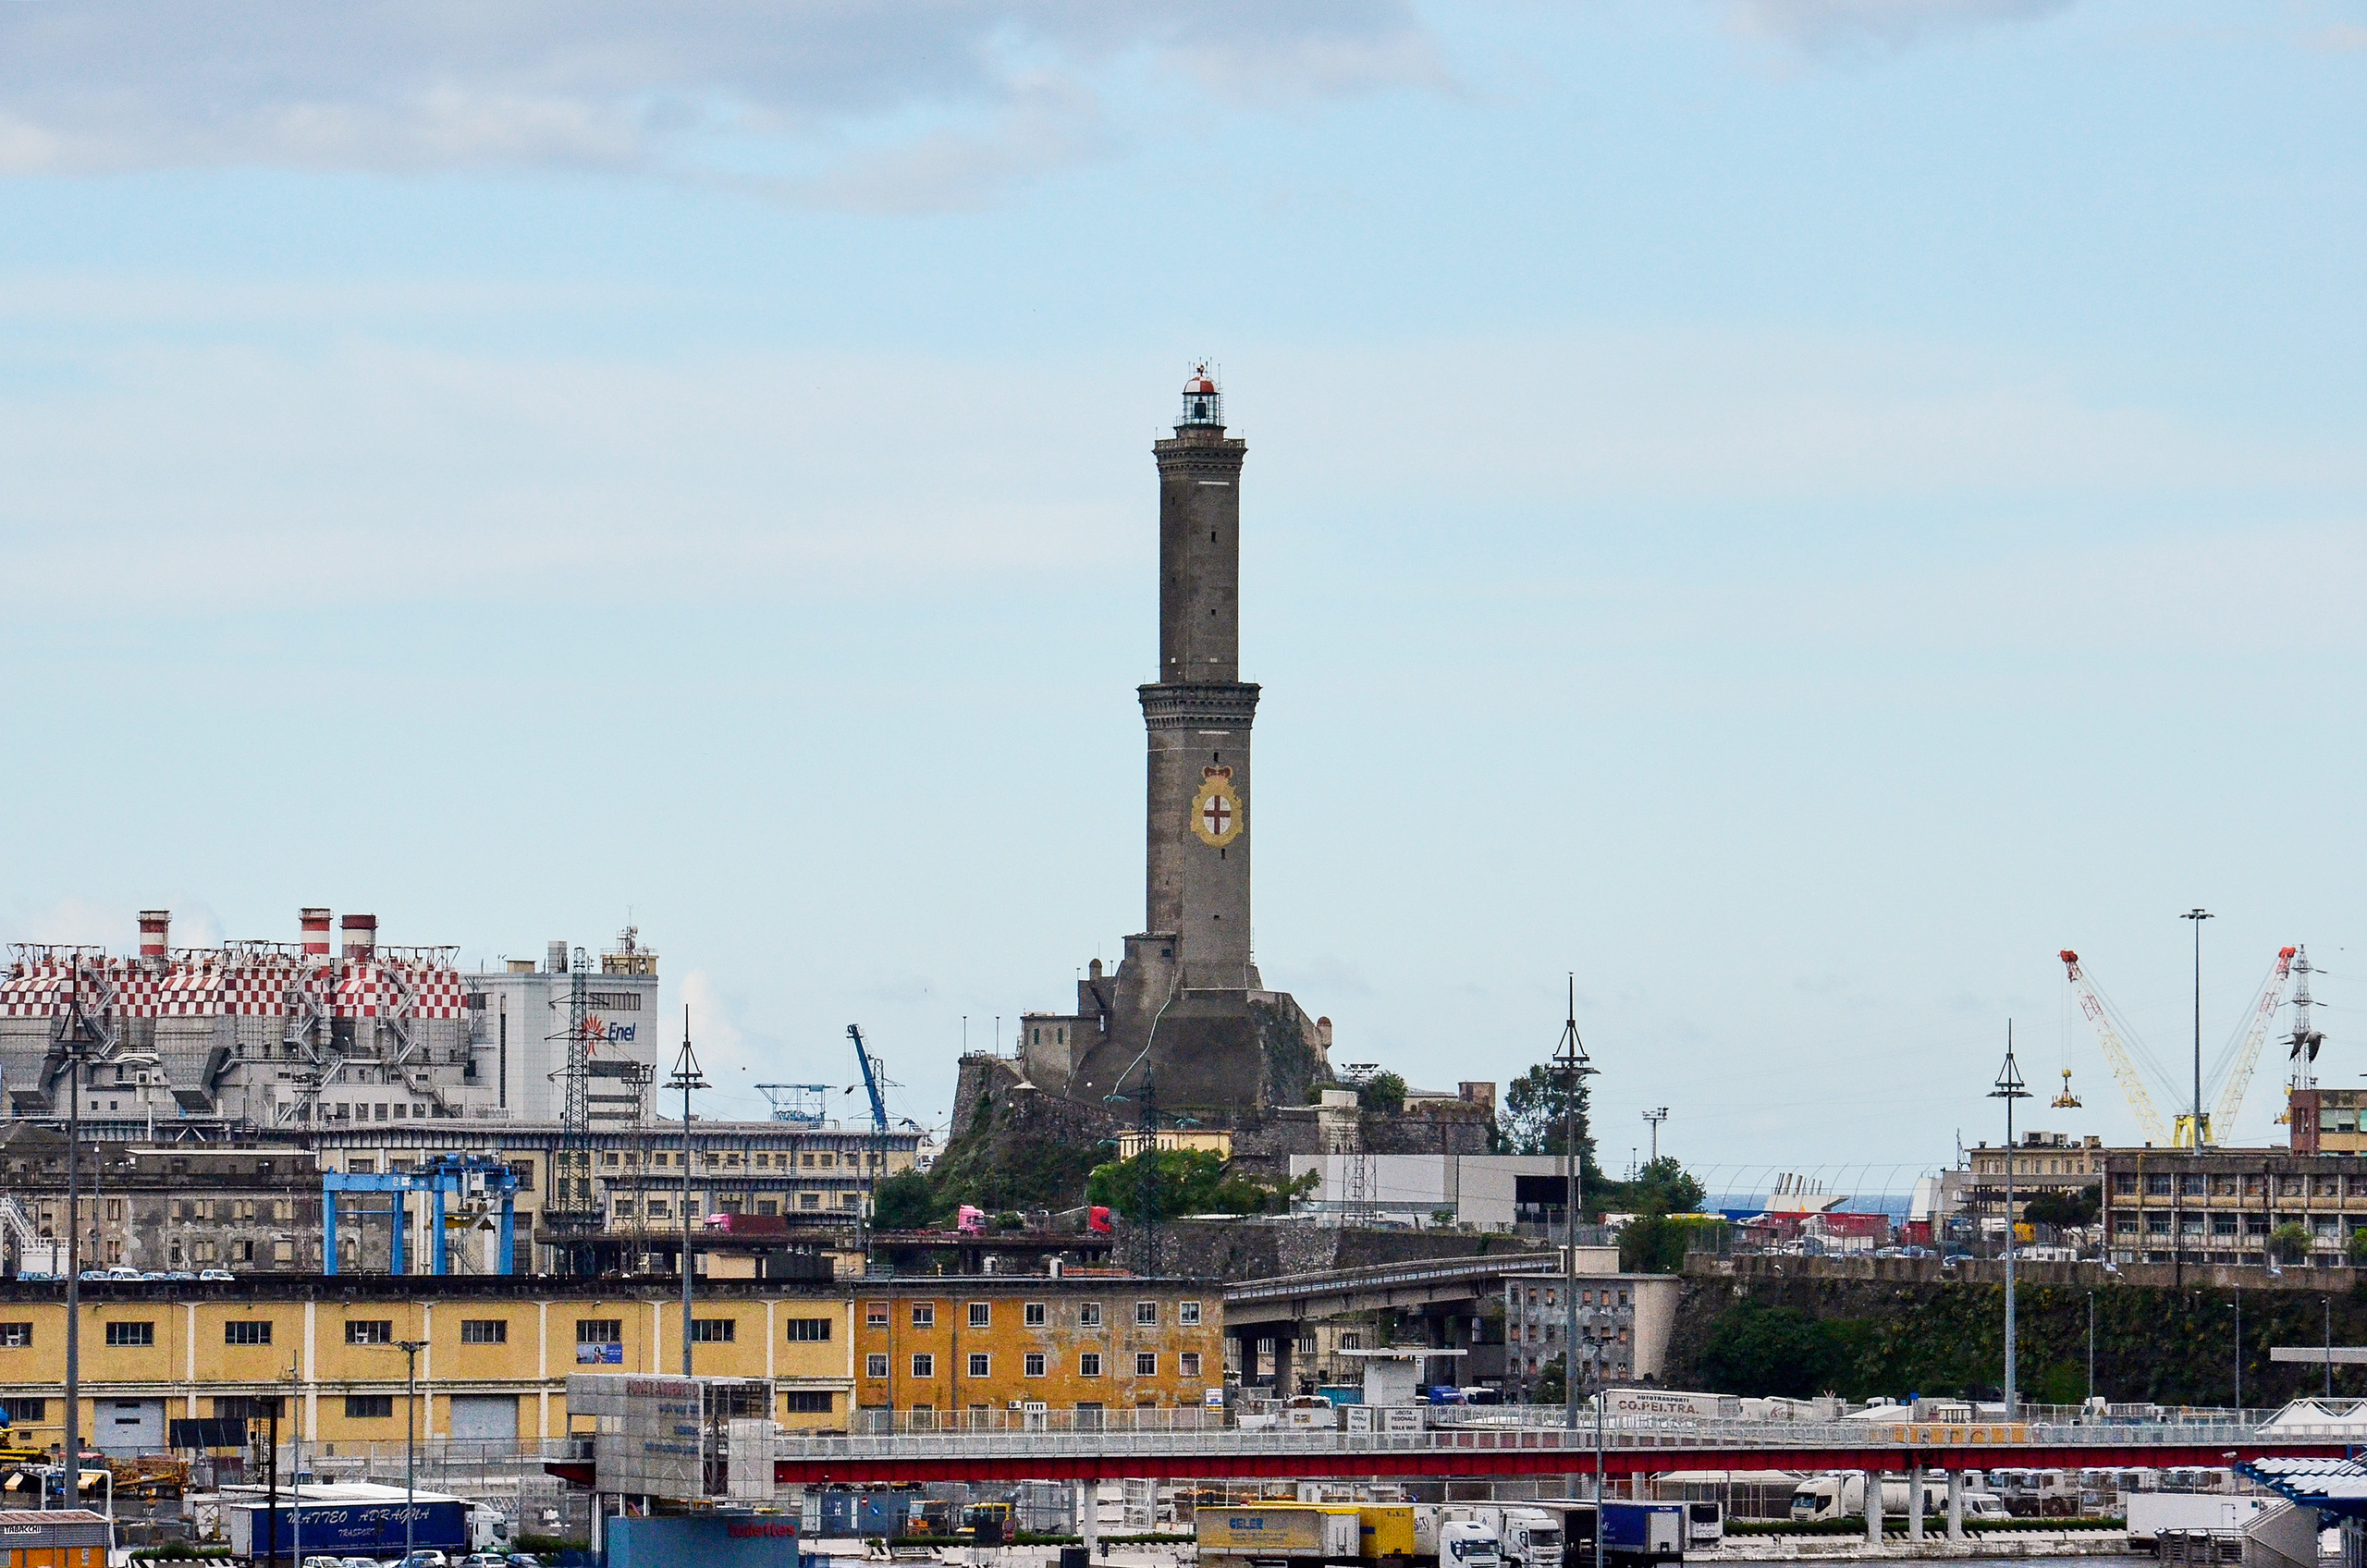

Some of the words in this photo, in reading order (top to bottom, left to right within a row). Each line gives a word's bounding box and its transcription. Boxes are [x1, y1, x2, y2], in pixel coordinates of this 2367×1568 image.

[609, 1022, 636, 1042] Enel
[1637, 1394, 1689, 1403] AUTOTRASPORTI
[286, 1511, 348, 1525] MATTEO
[358, 1507, 431, 1525] ADRAGNA
[5, 1525, 41, 1534] TABACCHI
[729, 1522, 796, 1537] toilettes
